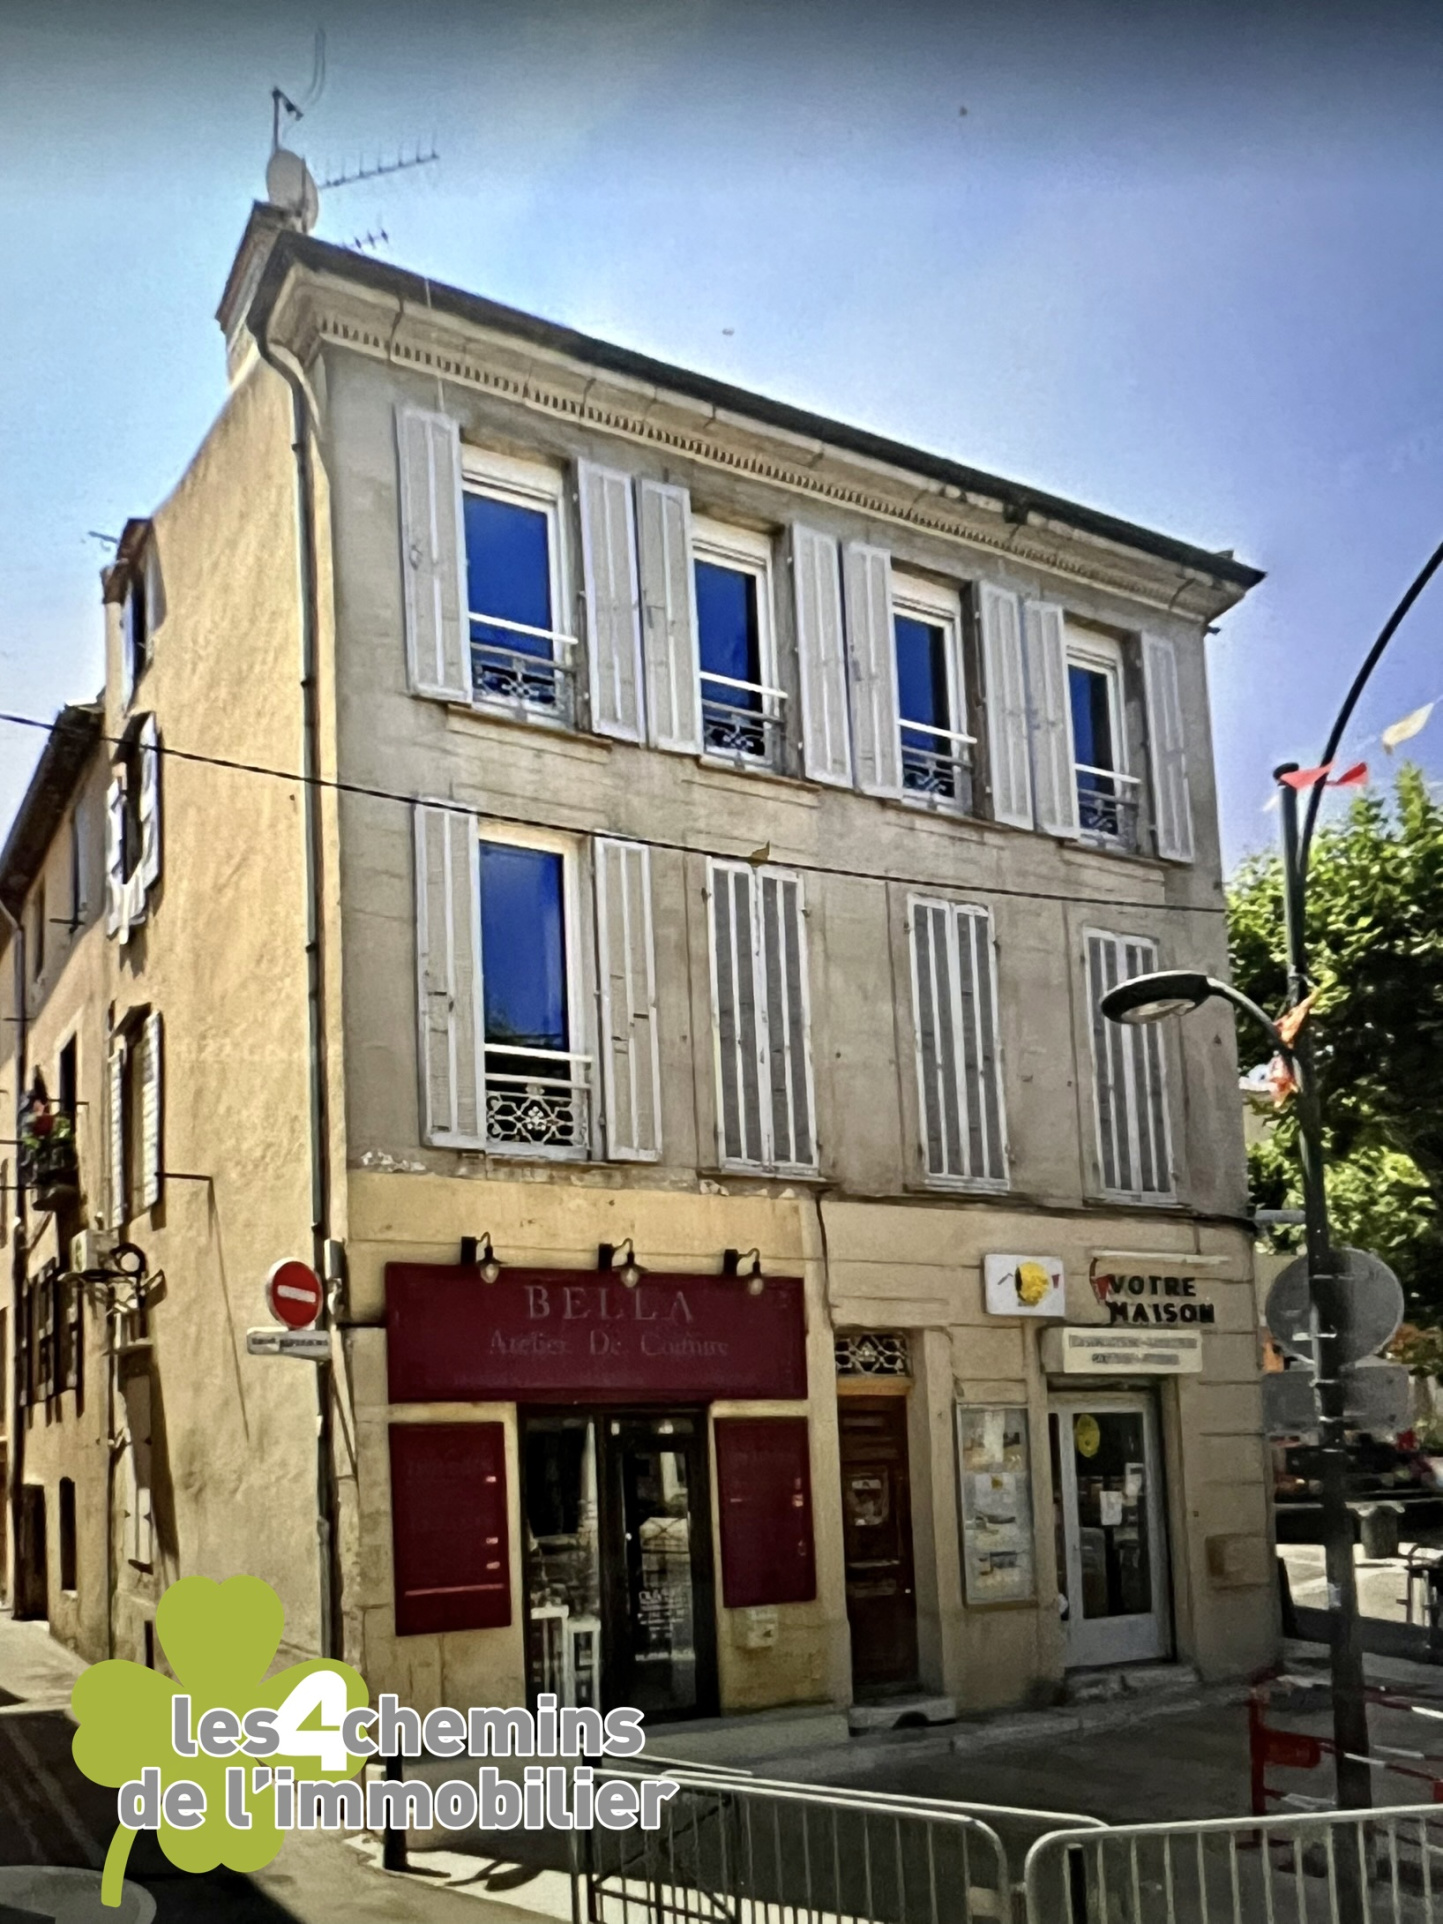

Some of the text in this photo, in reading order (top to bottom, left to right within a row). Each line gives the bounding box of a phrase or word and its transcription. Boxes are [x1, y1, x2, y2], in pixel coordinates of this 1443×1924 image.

[1107, 1274, 1197, 1297] VOTRE
[524, 1285, 694, 1324] BELLA
[1107, 1301, 1215, 1324] MAISON
